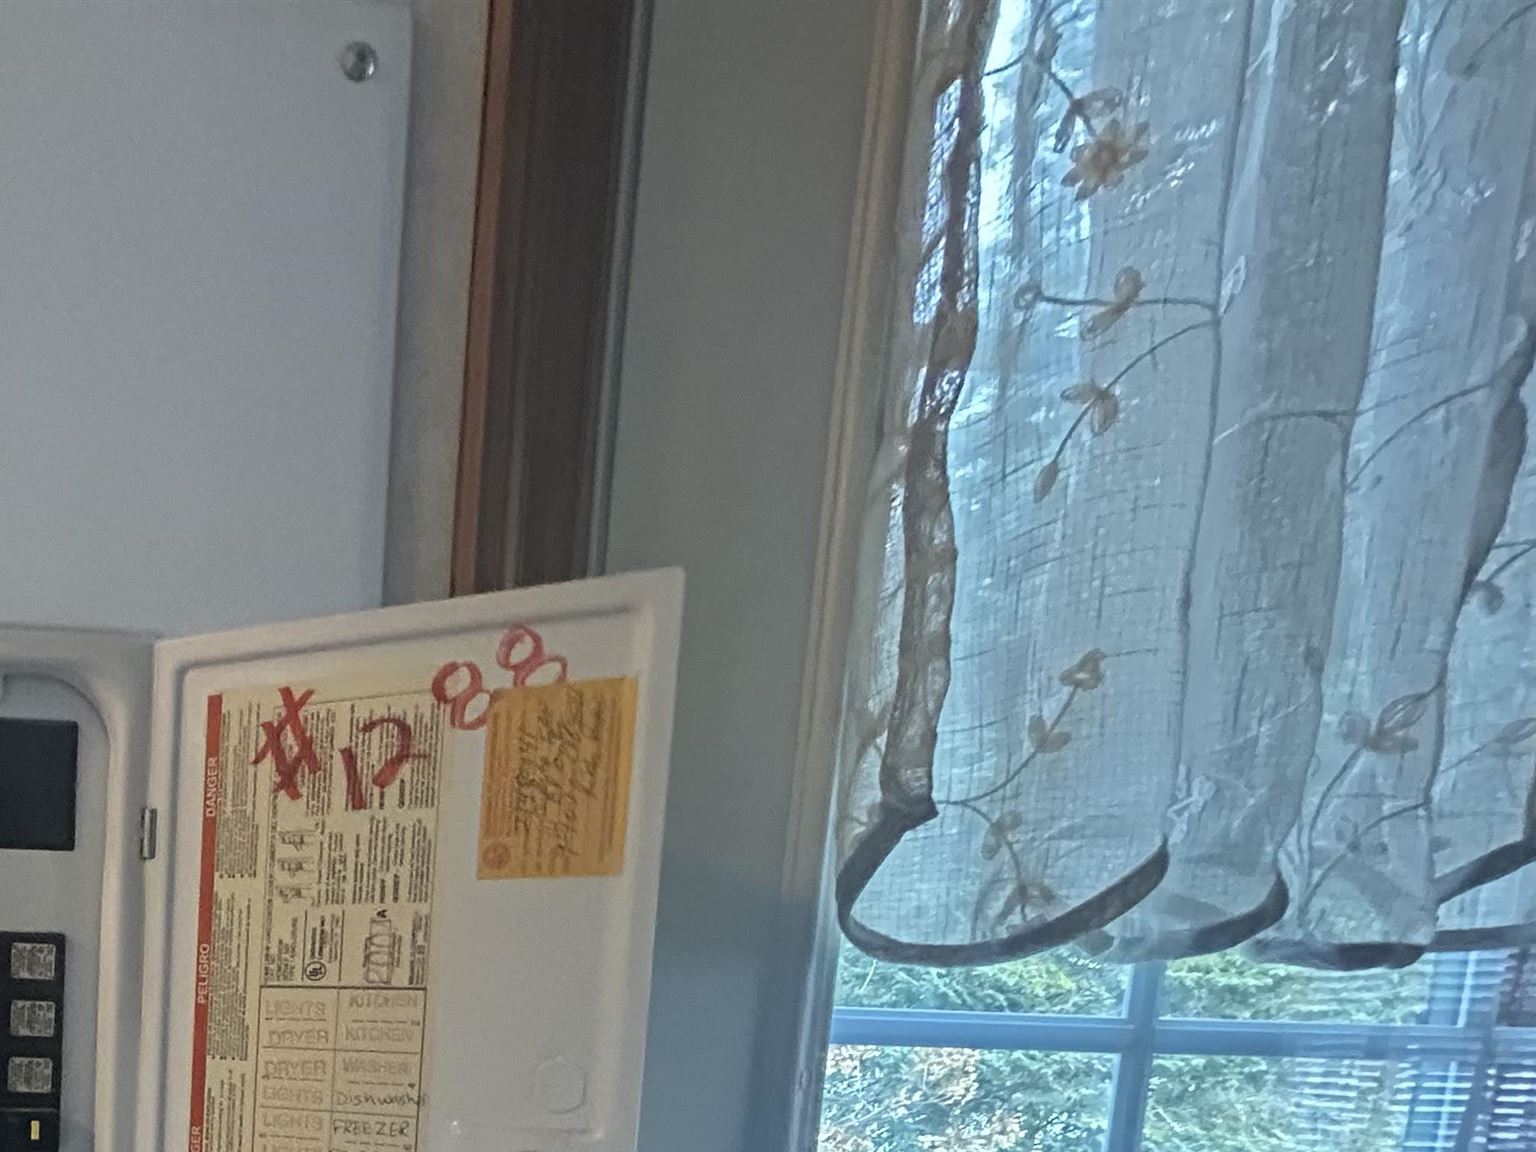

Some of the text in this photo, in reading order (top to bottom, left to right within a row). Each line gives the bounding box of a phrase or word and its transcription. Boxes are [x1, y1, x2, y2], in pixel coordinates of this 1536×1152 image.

[205, 757, 218, 818] DANGER
[198, 943, 211, 1004] PELIGRO
[332, 1118, 410, 1138] FREEZER
